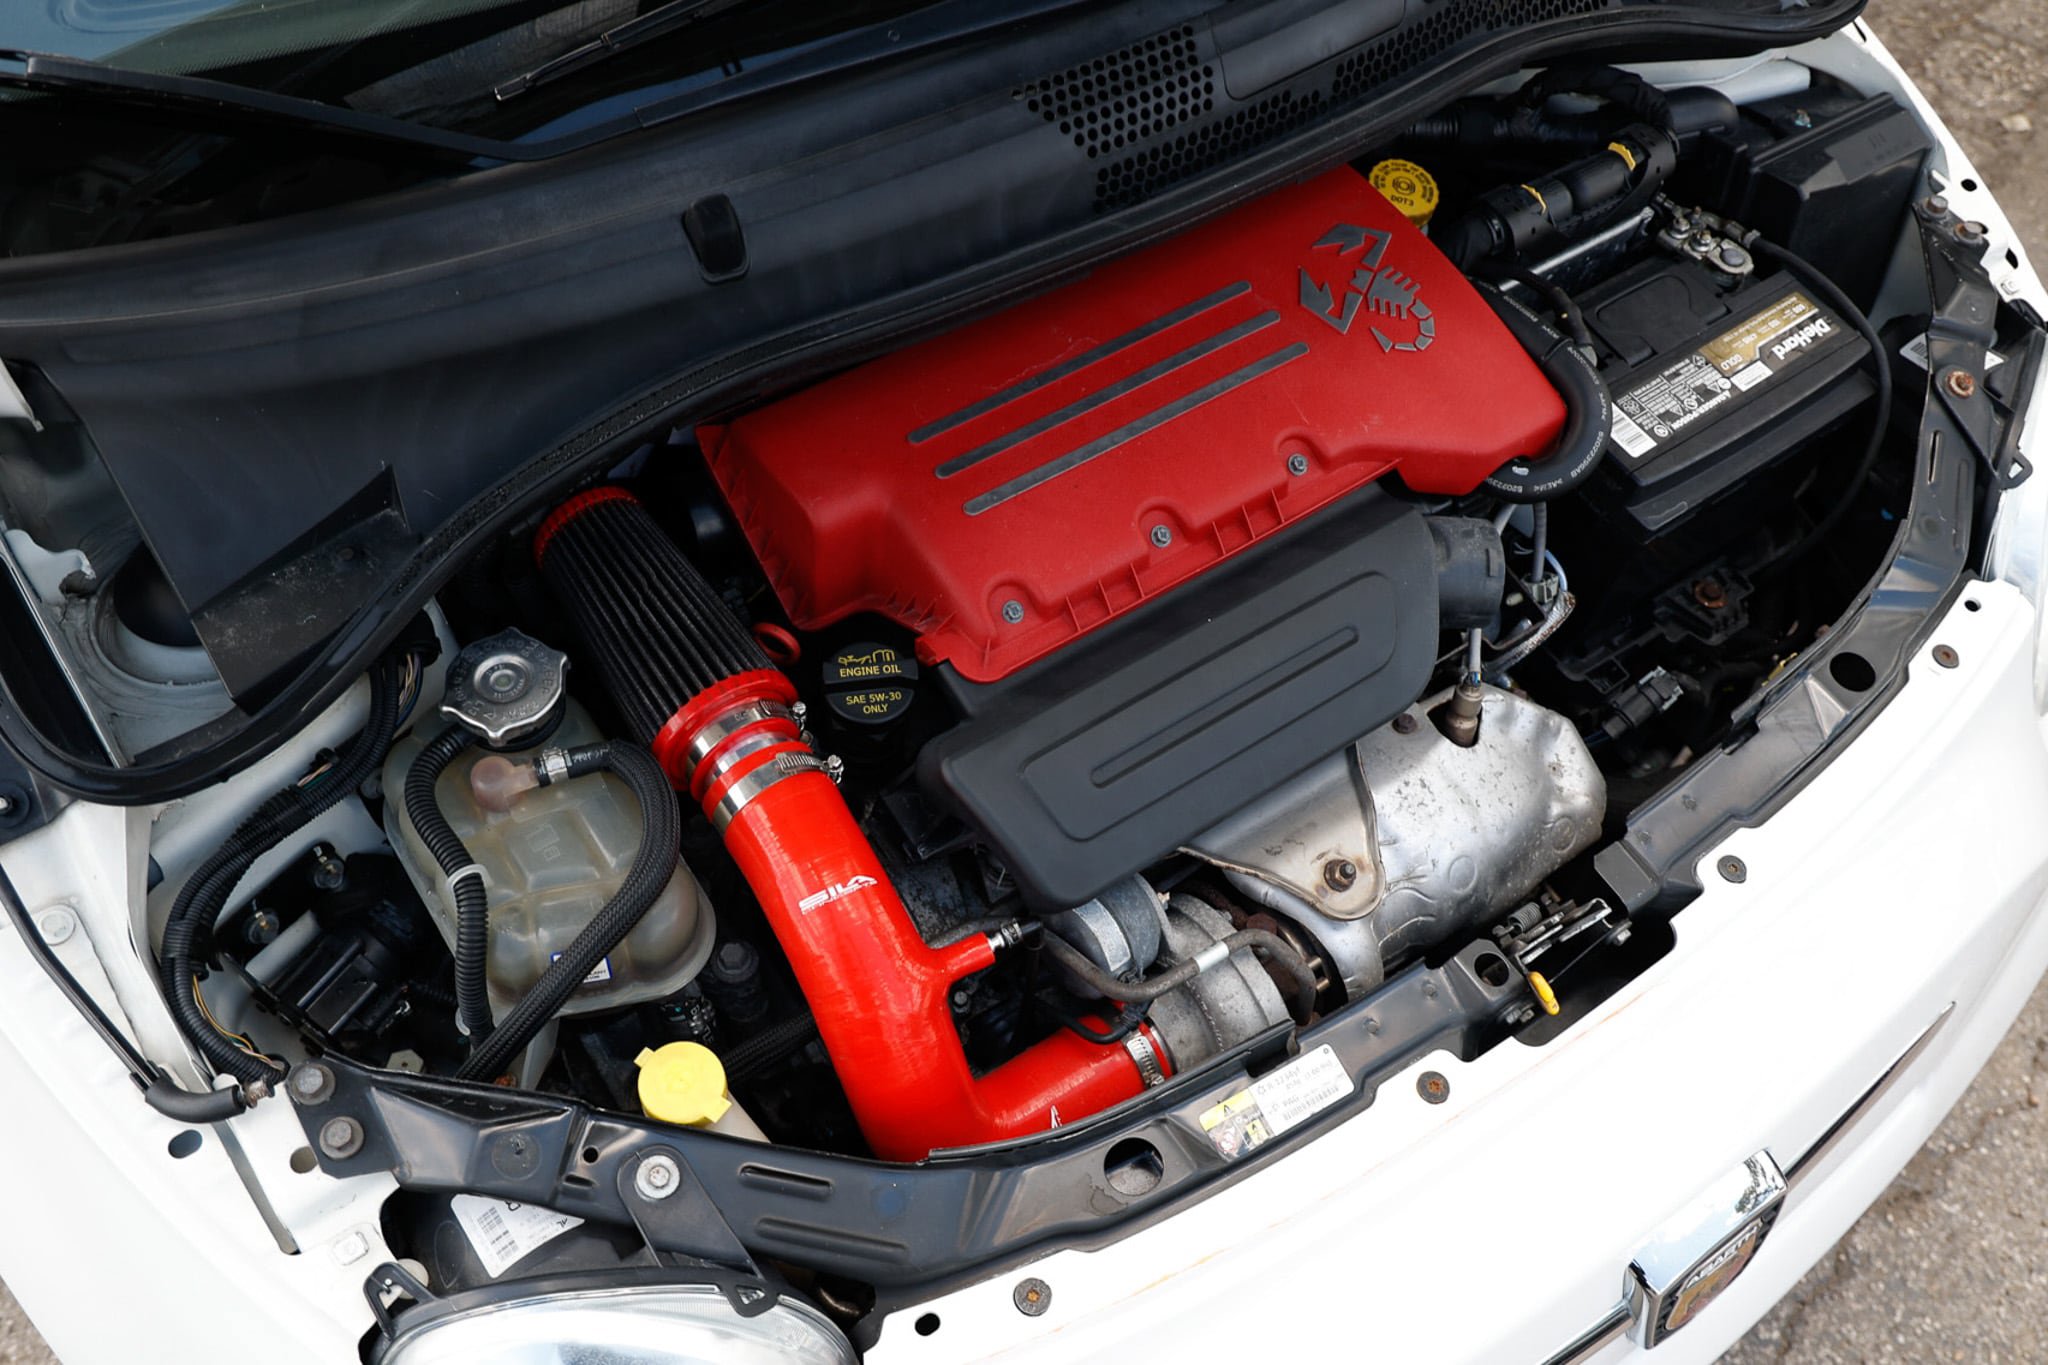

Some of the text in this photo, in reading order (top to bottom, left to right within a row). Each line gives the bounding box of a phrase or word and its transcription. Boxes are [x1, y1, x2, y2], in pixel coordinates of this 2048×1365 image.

[1771, 317, 1832, 360] DieHard
[1720, 354, 1743, 370] GOLD
[839, 664, 902, 678] ENGINE OIL
[845, 691, 902, 705] SAE 5W-30
[862, 703, 889, 714] ONLY
[798, 875, 878, 911] SILA
